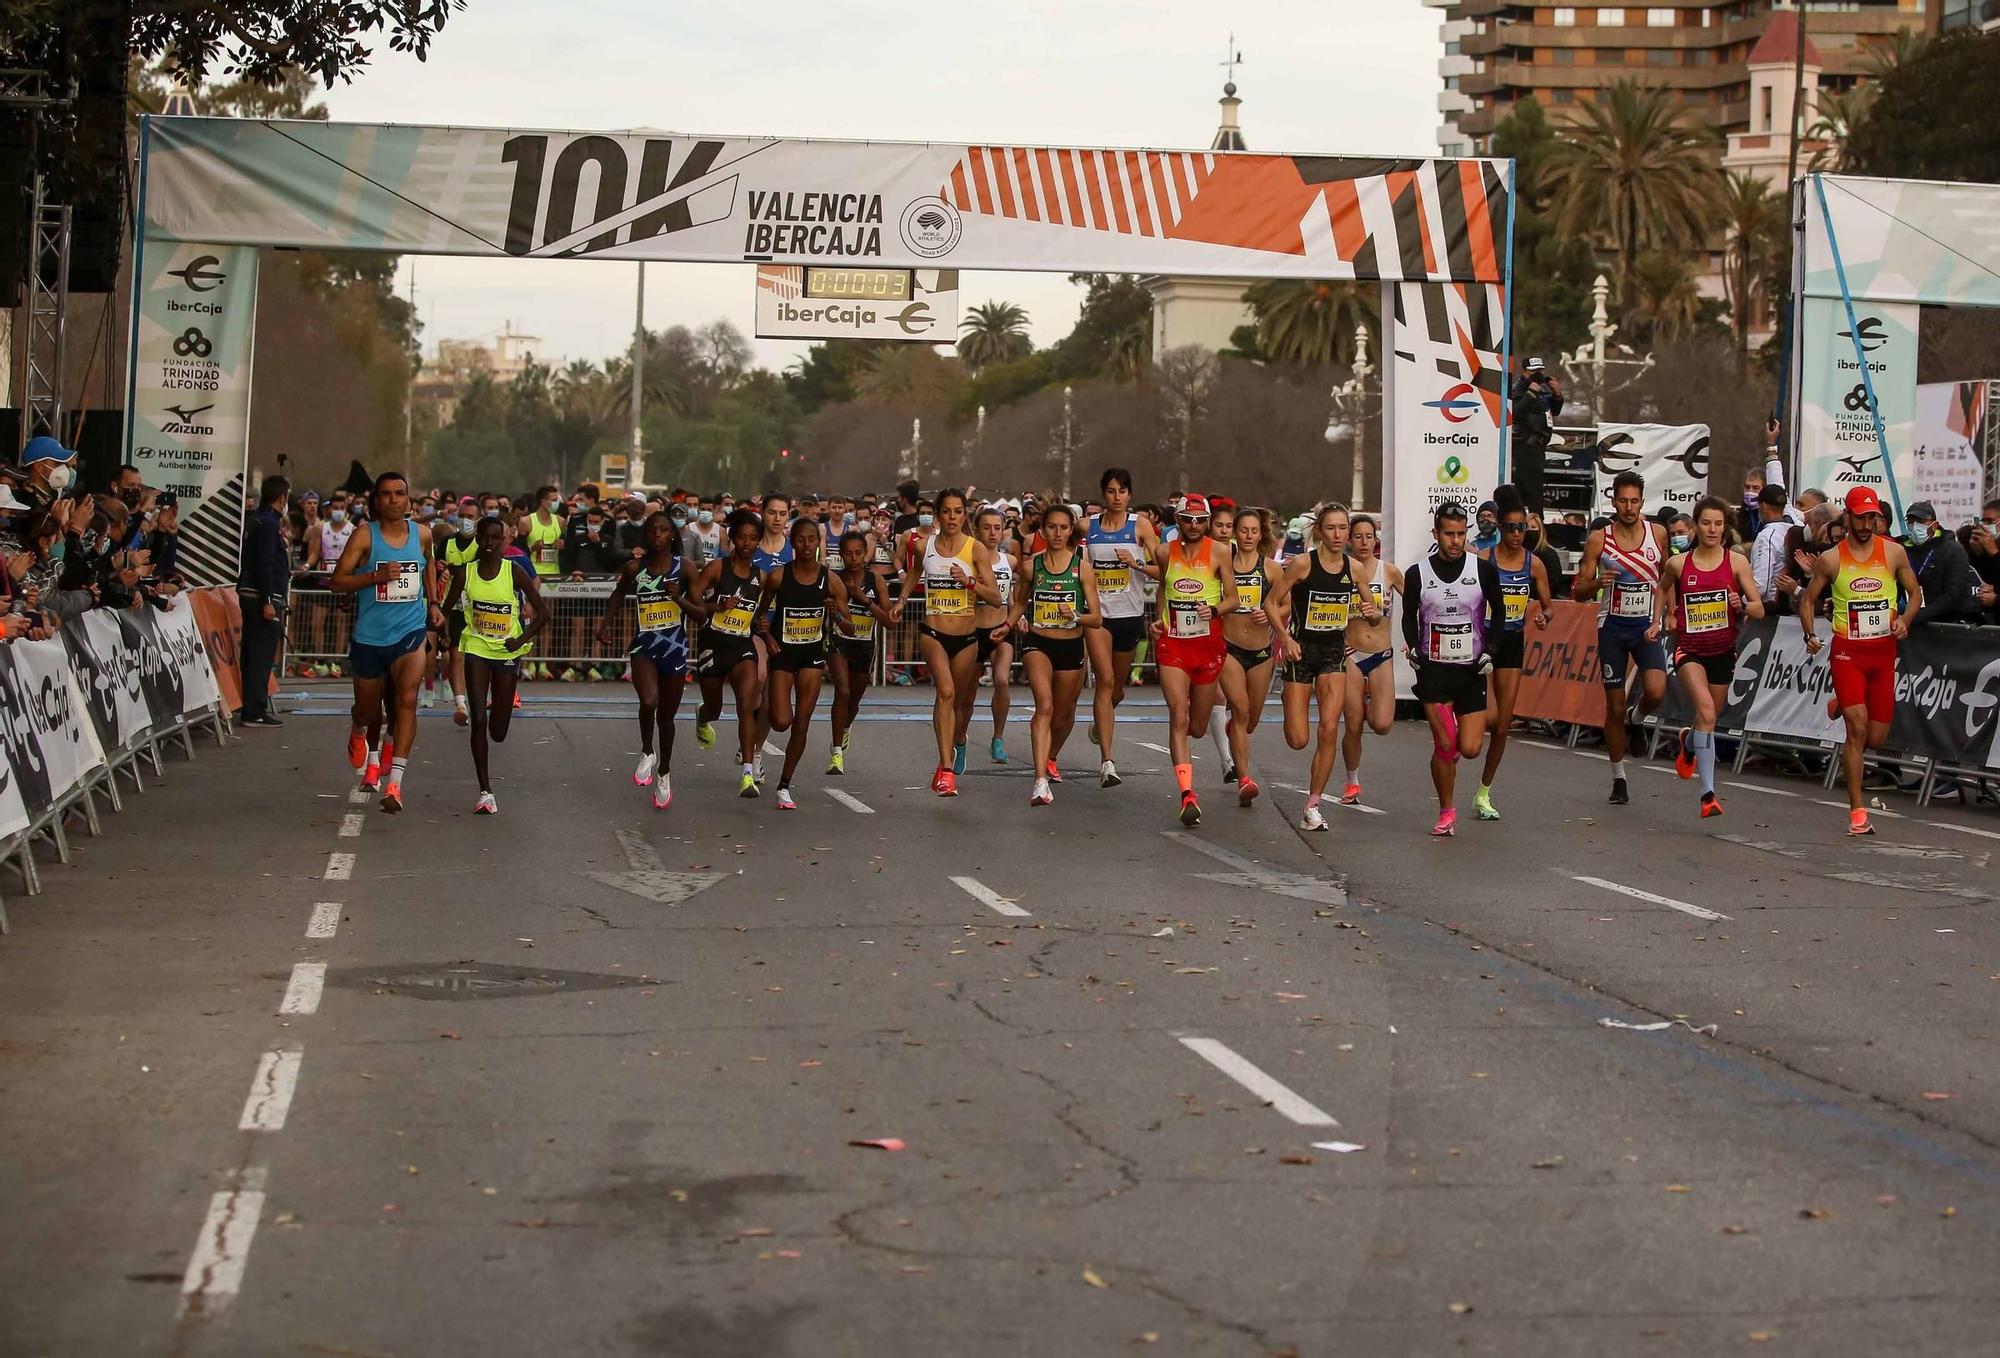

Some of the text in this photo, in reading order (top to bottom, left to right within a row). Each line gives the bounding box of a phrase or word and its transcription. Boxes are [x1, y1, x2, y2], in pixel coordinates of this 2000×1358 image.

[501, 134, 724, 257] 10K
[748, 191, 882, 223] VALENCIA
[745, 224, 881, 256] IBERCAJA
[812, 272, 906, 295] 0:00:03
[167, 300, 222, 317] iberCaja
[777, 303, 876, 328] iberCaja
[162, 367, 219, 380] TRINIDAD
[162, 379, 219, 391] ALFONSO
[1835, 414, 1885, 422] FUNDACIN
[161, 422, 214, 436] MIZUNO
[1425, 433, 1478, 448] iberCaja
[1835, 433, 1877, 442] ALFONS
[158, 448, 213, 462] HYUNDAI
[188, 463, 212, 472] Motor
[1835, 472, 1882, 483] MIZUNO
[1428, 485, 1477, 494] FUNDACIÓN
[1428, 495, 1478, 504] TRINIDAD
[398, 578, 409, 589] 56
[1097, 578, 1125, 586] BEATRIZ
[1177, 582, 1201, 590] Serrano
[1853, 581, 1880, 590] Serrano
[931, 598, 961, 607] MAITANE
[1240, 595, 1251, 603] VIS
[1625, 596, 1645, 606] 2144
[1506, 604, 1519, 613] HTA
[723, 615, 746, 628] ZERAY
[1185, 616, 1197, 625] 67
[1688, 611, 1726, 623] BOUCHARD
[1868, 616, 1880, 626] 68
[475, 619, 507, 632] CHESANG
[1450, 639, 1462, 649] 66
